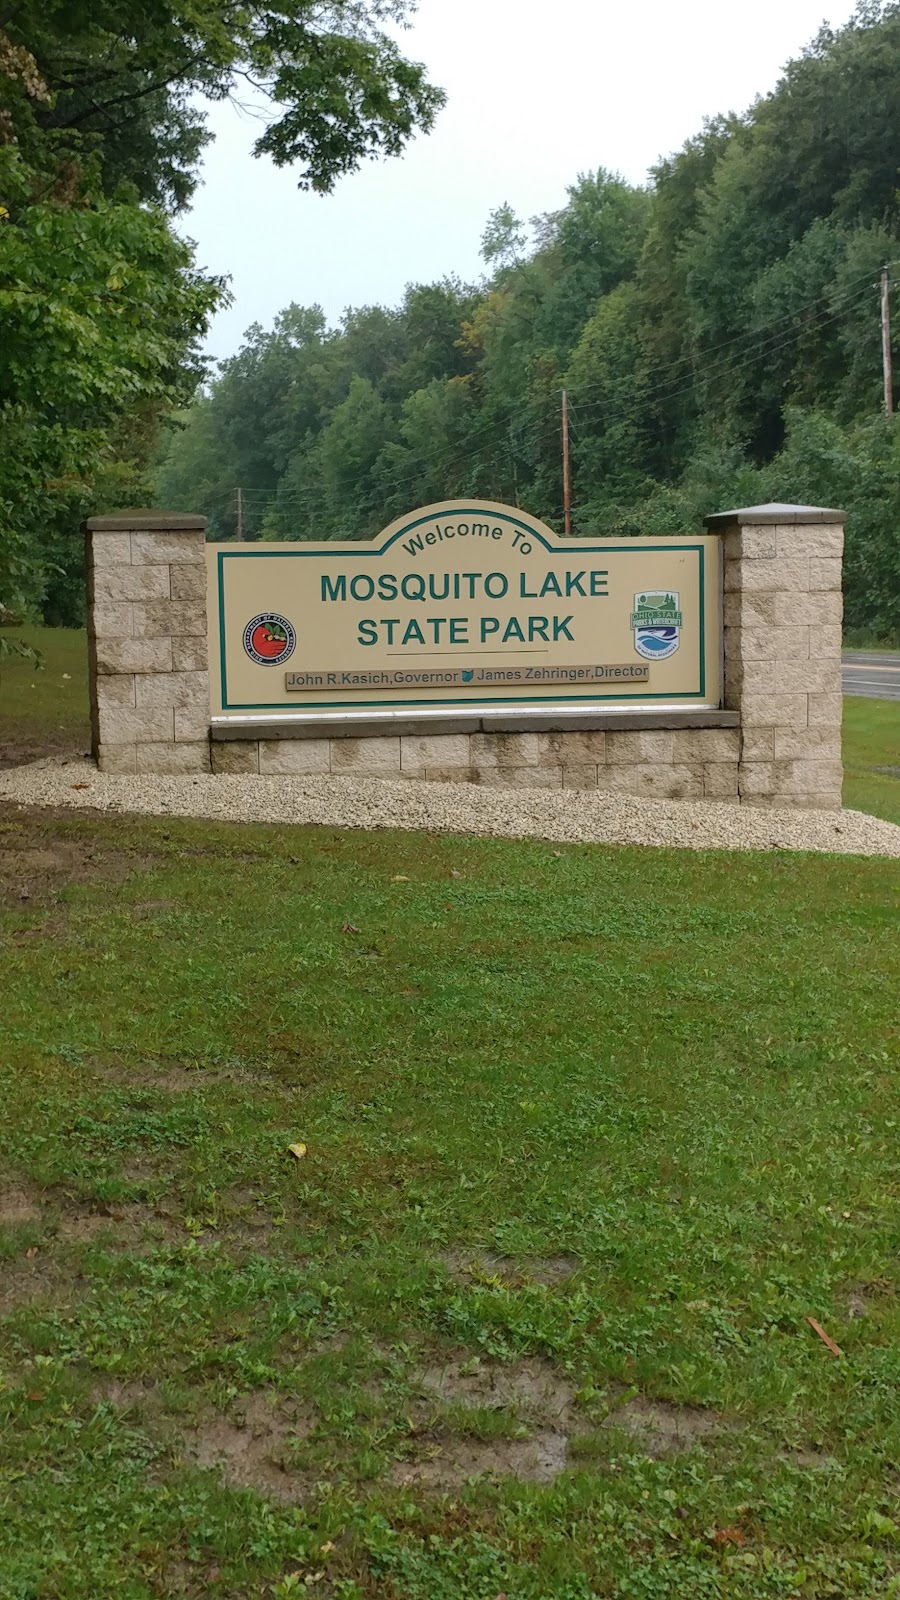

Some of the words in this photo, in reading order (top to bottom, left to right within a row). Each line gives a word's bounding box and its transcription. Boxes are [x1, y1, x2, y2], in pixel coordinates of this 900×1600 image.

[402, 523, 503, 557] Welcome
[511, 529, 533, 556] To
[320, 572, 510, 602] MOSQUITO
[519, 570, 609, 598] LAKE
[357, 617, 469, 646] STATE
[480, 615, 575, 643] PARK
[287, 673, 323, 686] John
[477, 669, 522, 681] James
